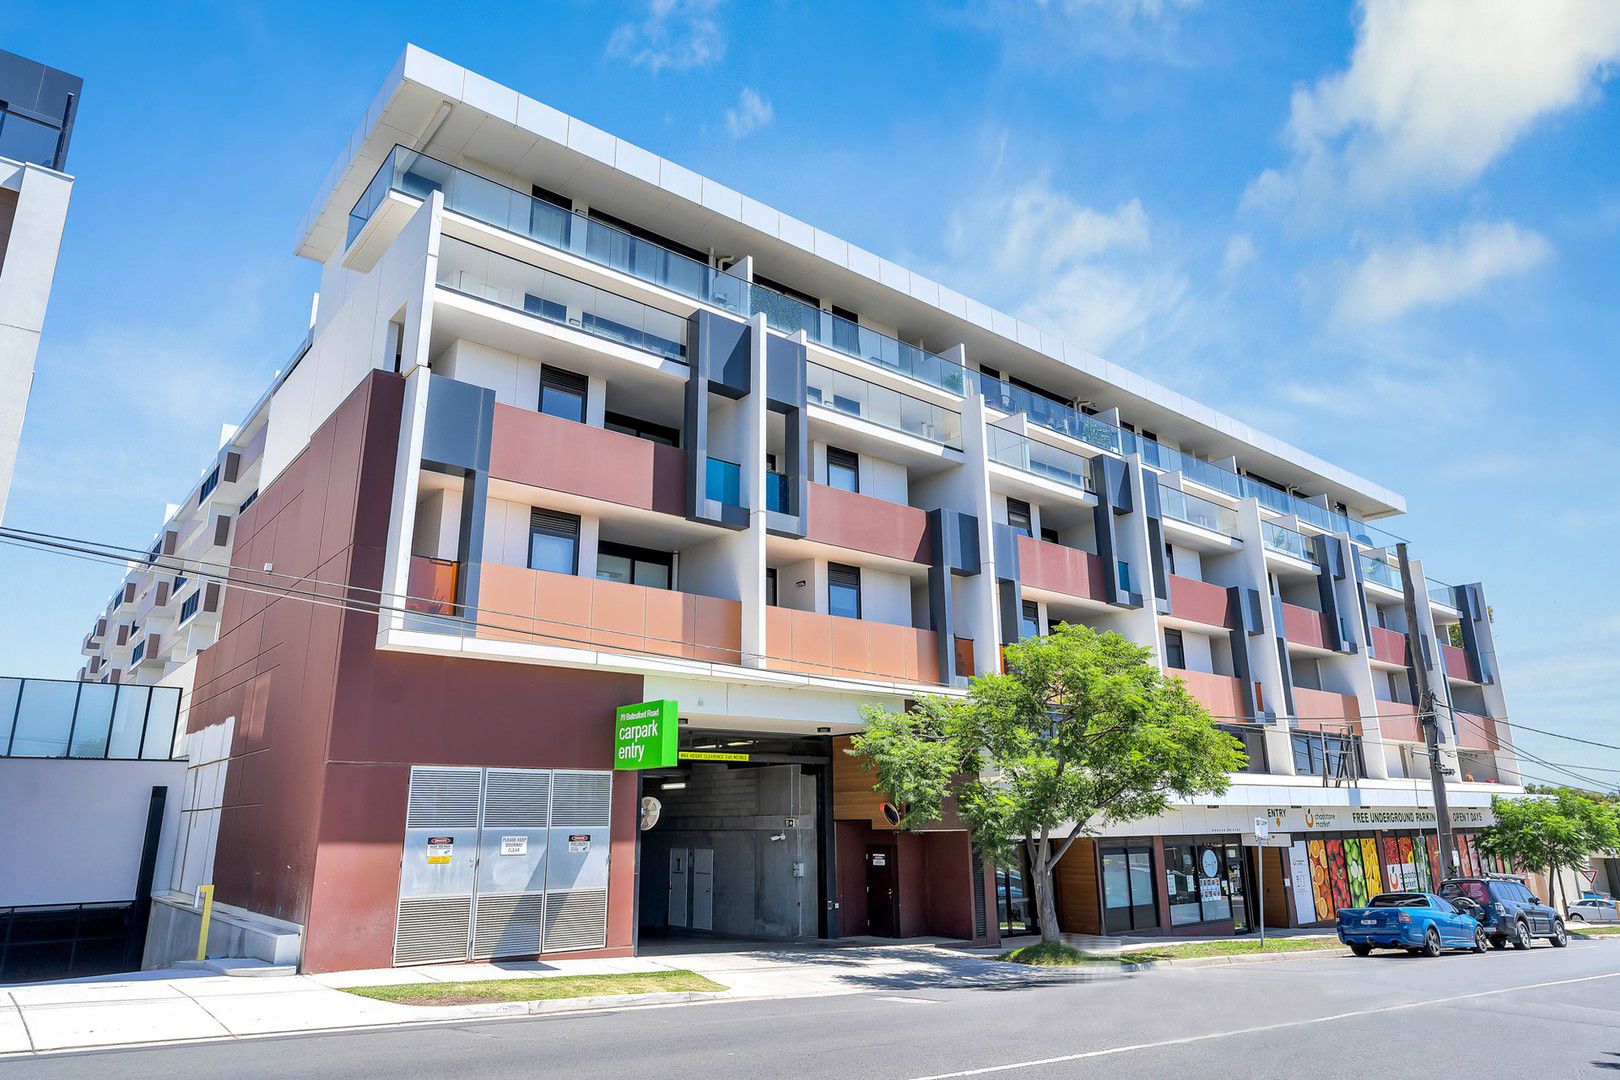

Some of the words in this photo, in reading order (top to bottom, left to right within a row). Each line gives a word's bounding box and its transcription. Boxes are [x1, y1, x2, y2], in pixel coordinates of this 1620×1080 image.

[647, 709, 659, 717] Road
[620, 719, 658, 742] carpark
[618, 742, 645, 762] entry
[1267, 809, 1286, 817] ENTRY
[1352, 812, 1369, 823] FREE
[1370, 812, 1414, 823] UNDERGROUND
[1416, 812, 1436, 822] PARKIN
[1453, 812, 1465, 822] OPEN
[1465, 812, 1469, 822] 7
[1470, 812, 1482, 821] DAYS
